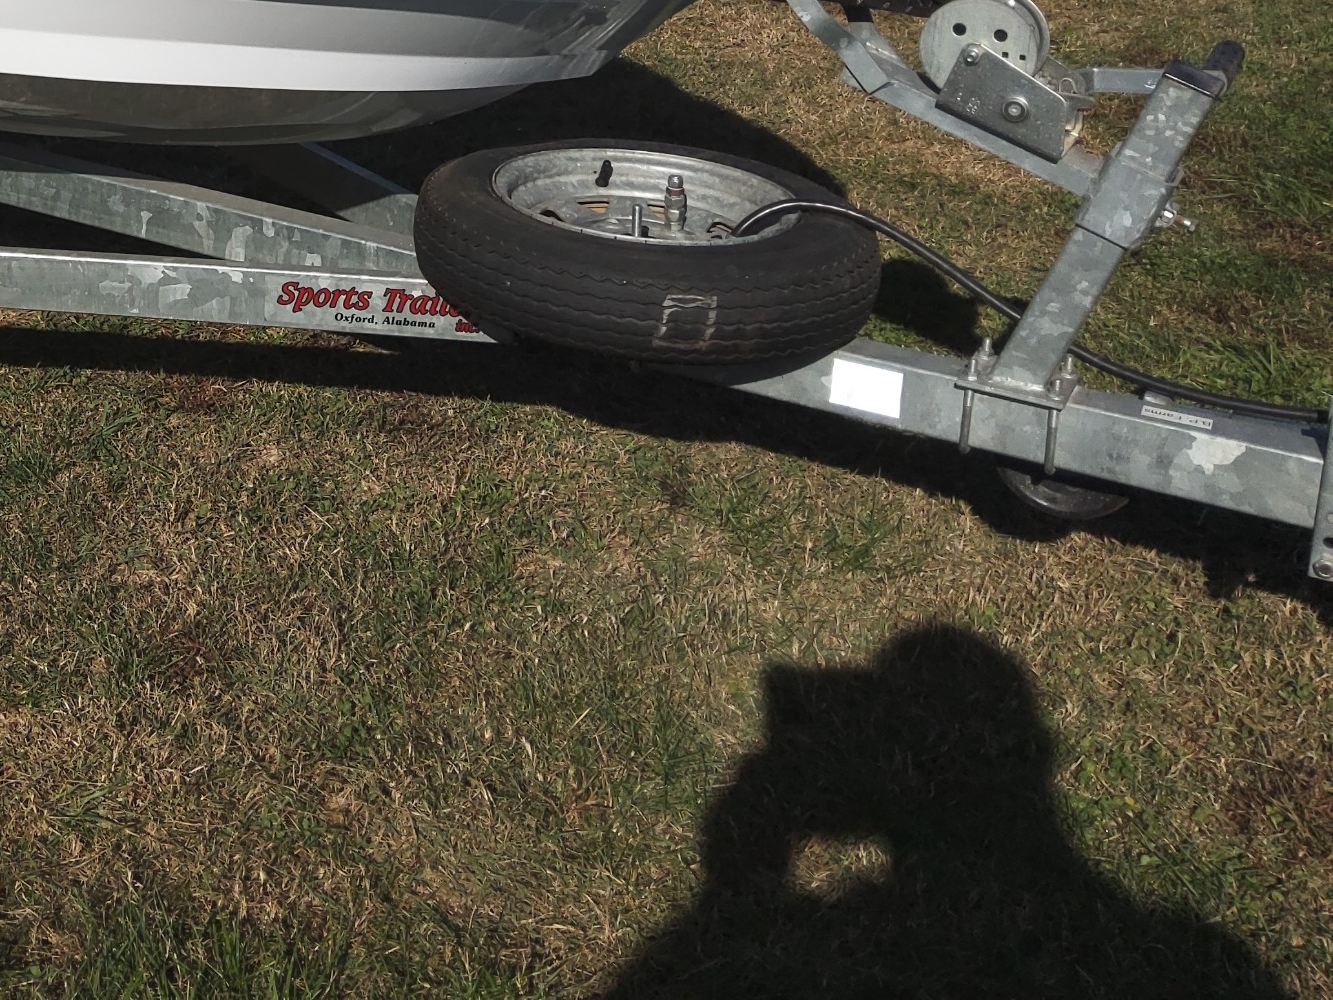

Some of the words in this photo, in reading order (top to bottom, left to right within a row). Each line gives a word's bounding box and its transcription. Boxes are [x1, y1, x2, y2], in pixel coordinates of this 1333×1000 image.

[277, 281, 373, 313] Sports
[334, 312, 378, 326] Oxford,
[382, 316, 436, 329] Alabama
